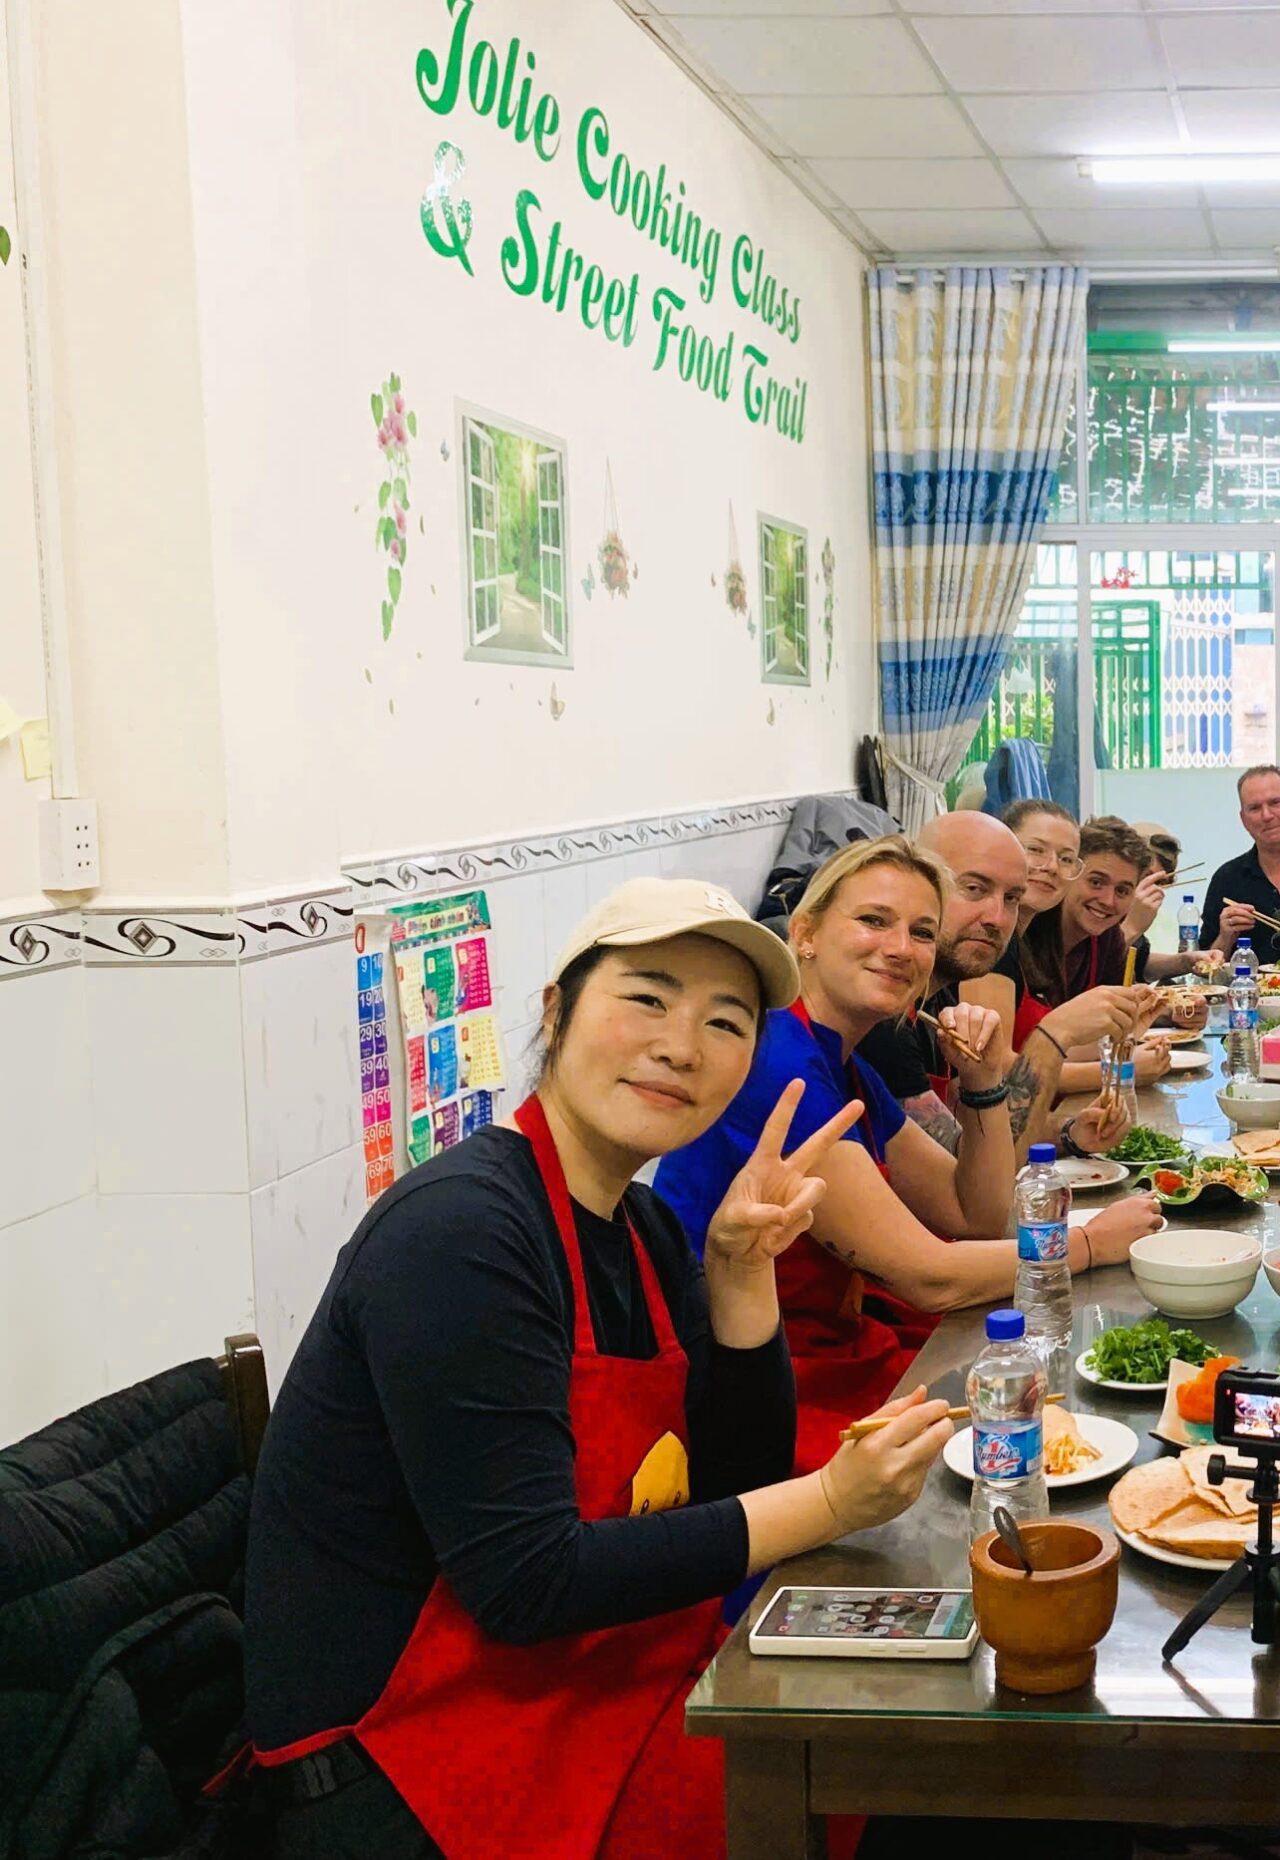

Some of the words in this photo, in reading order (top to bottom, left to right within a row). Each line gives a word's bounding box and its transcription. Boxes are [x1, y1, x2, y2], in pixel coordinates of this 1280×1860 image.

[415, 0, 561, 162] Jolie
[576, 107, 722, 304] Cooking
[731, 234, 801, 344] Class
[419, 140, 475, 278] &
[500, 189, 641, 348] Street
[652, 287, 735, 402] Food
[742, 344, 807, 444] Trail
[361, 959, 368, 973] 9
[360, 992, 373, 1008] 19
[360, 1025, 373, 1042] 29
[360, 1059, 374, 1076] 39
[376, 1053, 389, 1070] 40
[376, 1089, 391, 1106] 50
[379, 1123, 393, 1140] 60
[368, 1160, 382, 1180] 69
